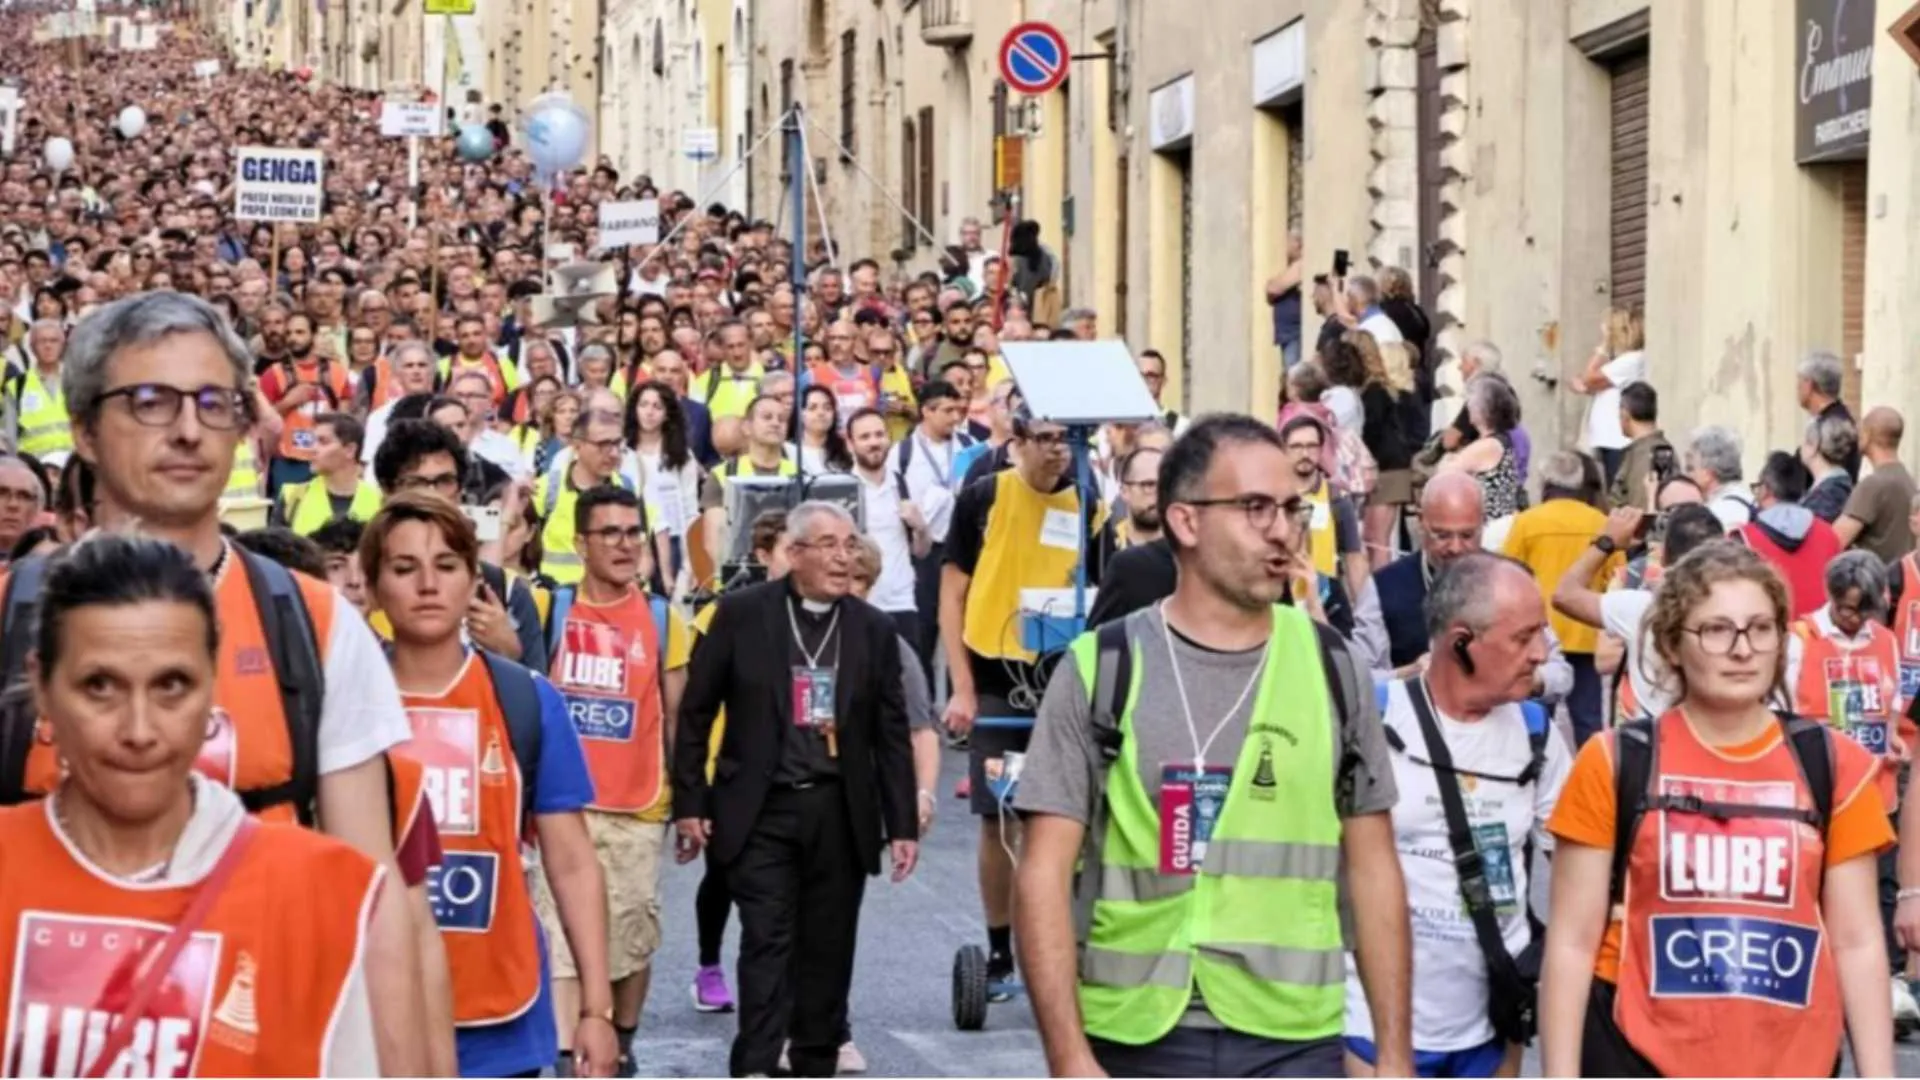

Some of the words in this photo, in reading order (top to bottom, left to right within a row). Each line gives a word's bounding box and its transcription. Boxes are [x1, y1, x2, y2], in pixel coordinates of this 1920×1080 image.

[243, 156, 316, 185] GENGA
[241, 205, 267, 217] PAPA
[269, 206, 299, 217] LEONE
[563, 652, 624, 690] LUBE
[569, 702, 629, 727] REO
[424, 767, 471, 826] BE
[1172, 804, 1190, 869] GUIDA
[1670, 831, 1788, 897] LUBE
[427, 865, 482, 905] EO
[33, 926, 146, 951] CUCI
[1666, 929, 1804, 978] CREO
